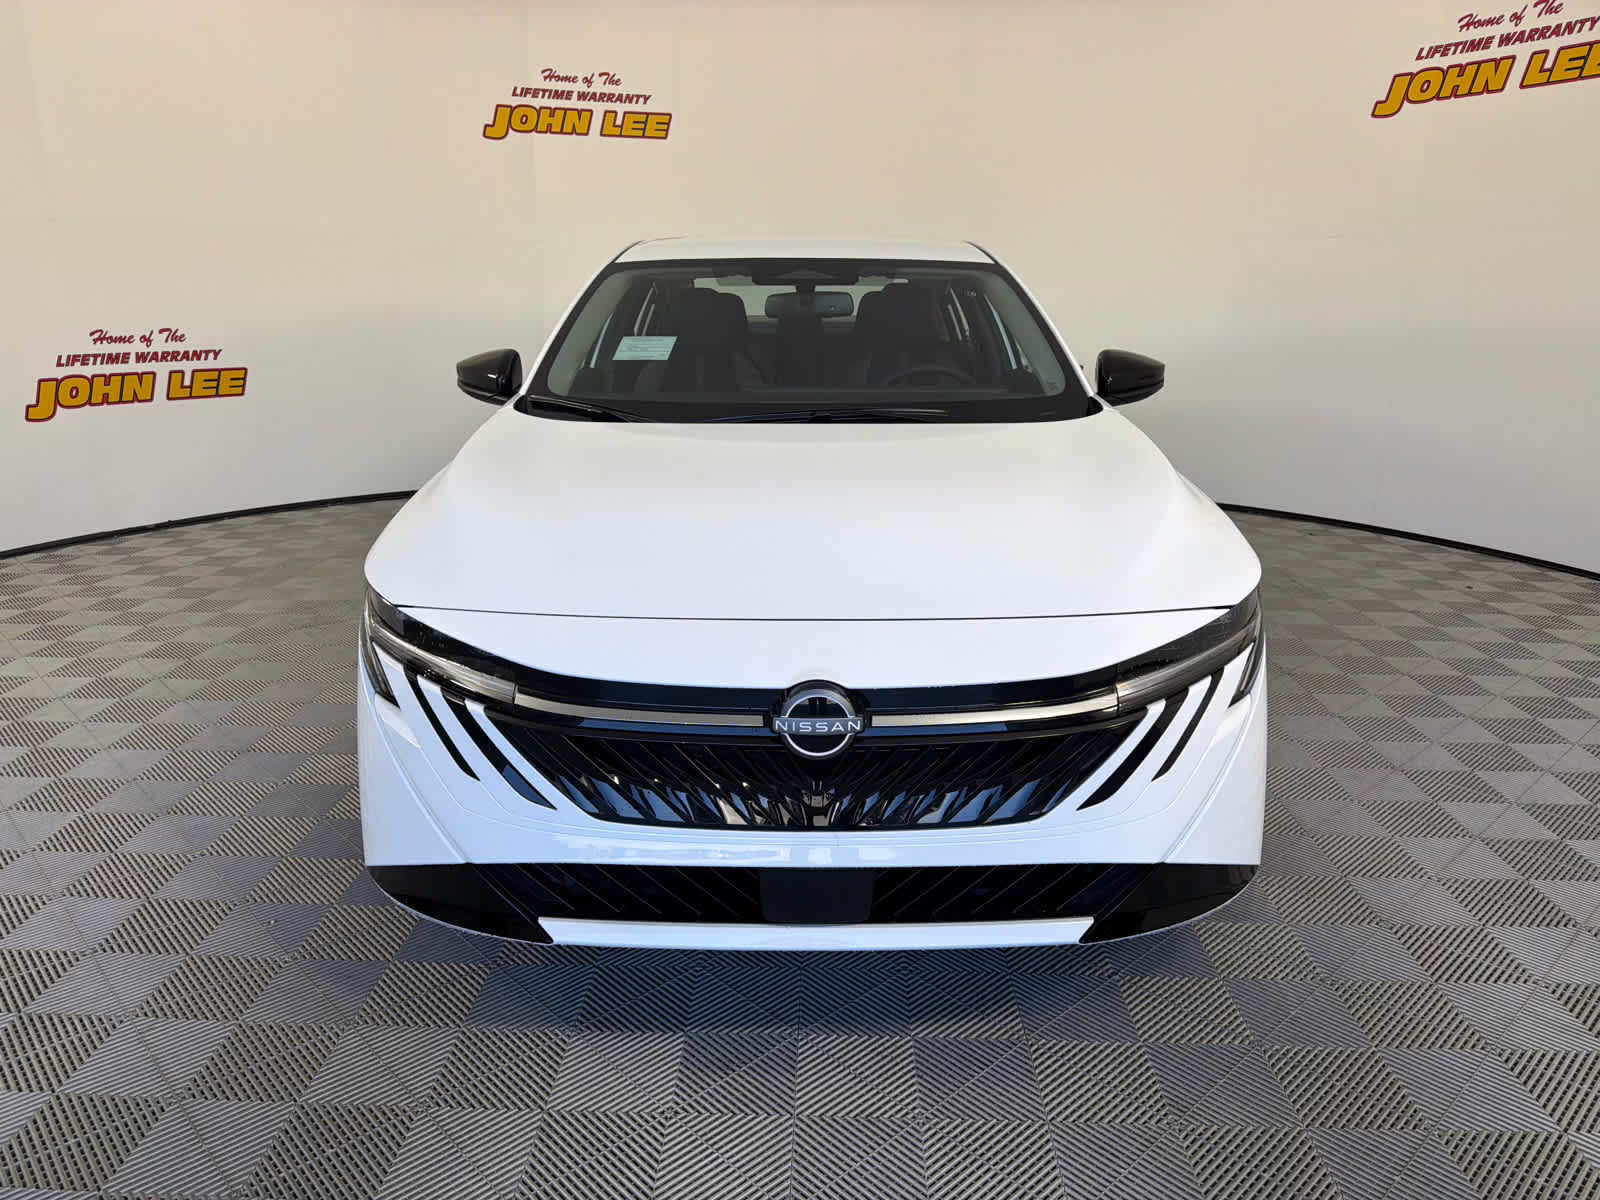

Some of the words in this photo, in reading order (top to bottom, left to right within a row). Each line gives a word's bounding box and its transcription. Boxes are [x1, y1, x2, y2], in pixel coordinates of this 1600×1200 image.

[1457, 13, 1505, 32] Home
[1509, 5, 1528, 26] of
[1533, 0, 1564, 18] The
[1415, 35, 1495, 61] LIFETIME
[1497, 16, 1600, 48] WARRANTY
[541, 68, 578, 84] Home
[582, 73, 595, 88] of
[598, 72, 622, 86] The
[1371, 55, 1517, 118] JOHN
[512, 86, 574, 101] LIFETIME
[576, 90, 652, 105] WARRANTY
[483, 104, 593, 140] JOHN
[600, 110, 672, 139] LEE
[89, 329, 135, 345] Home
[139, 330, 154, 347] of
[158, 328, 186, 343] The
[56, 352, 130, 368] LIFETIME
[135, 349, 222, 363] WARRANTY
[25, 371, 156, 422] JOHN
[166, 367, 248, 401] LEE
[775, 720, 861, 732] NISSAN
